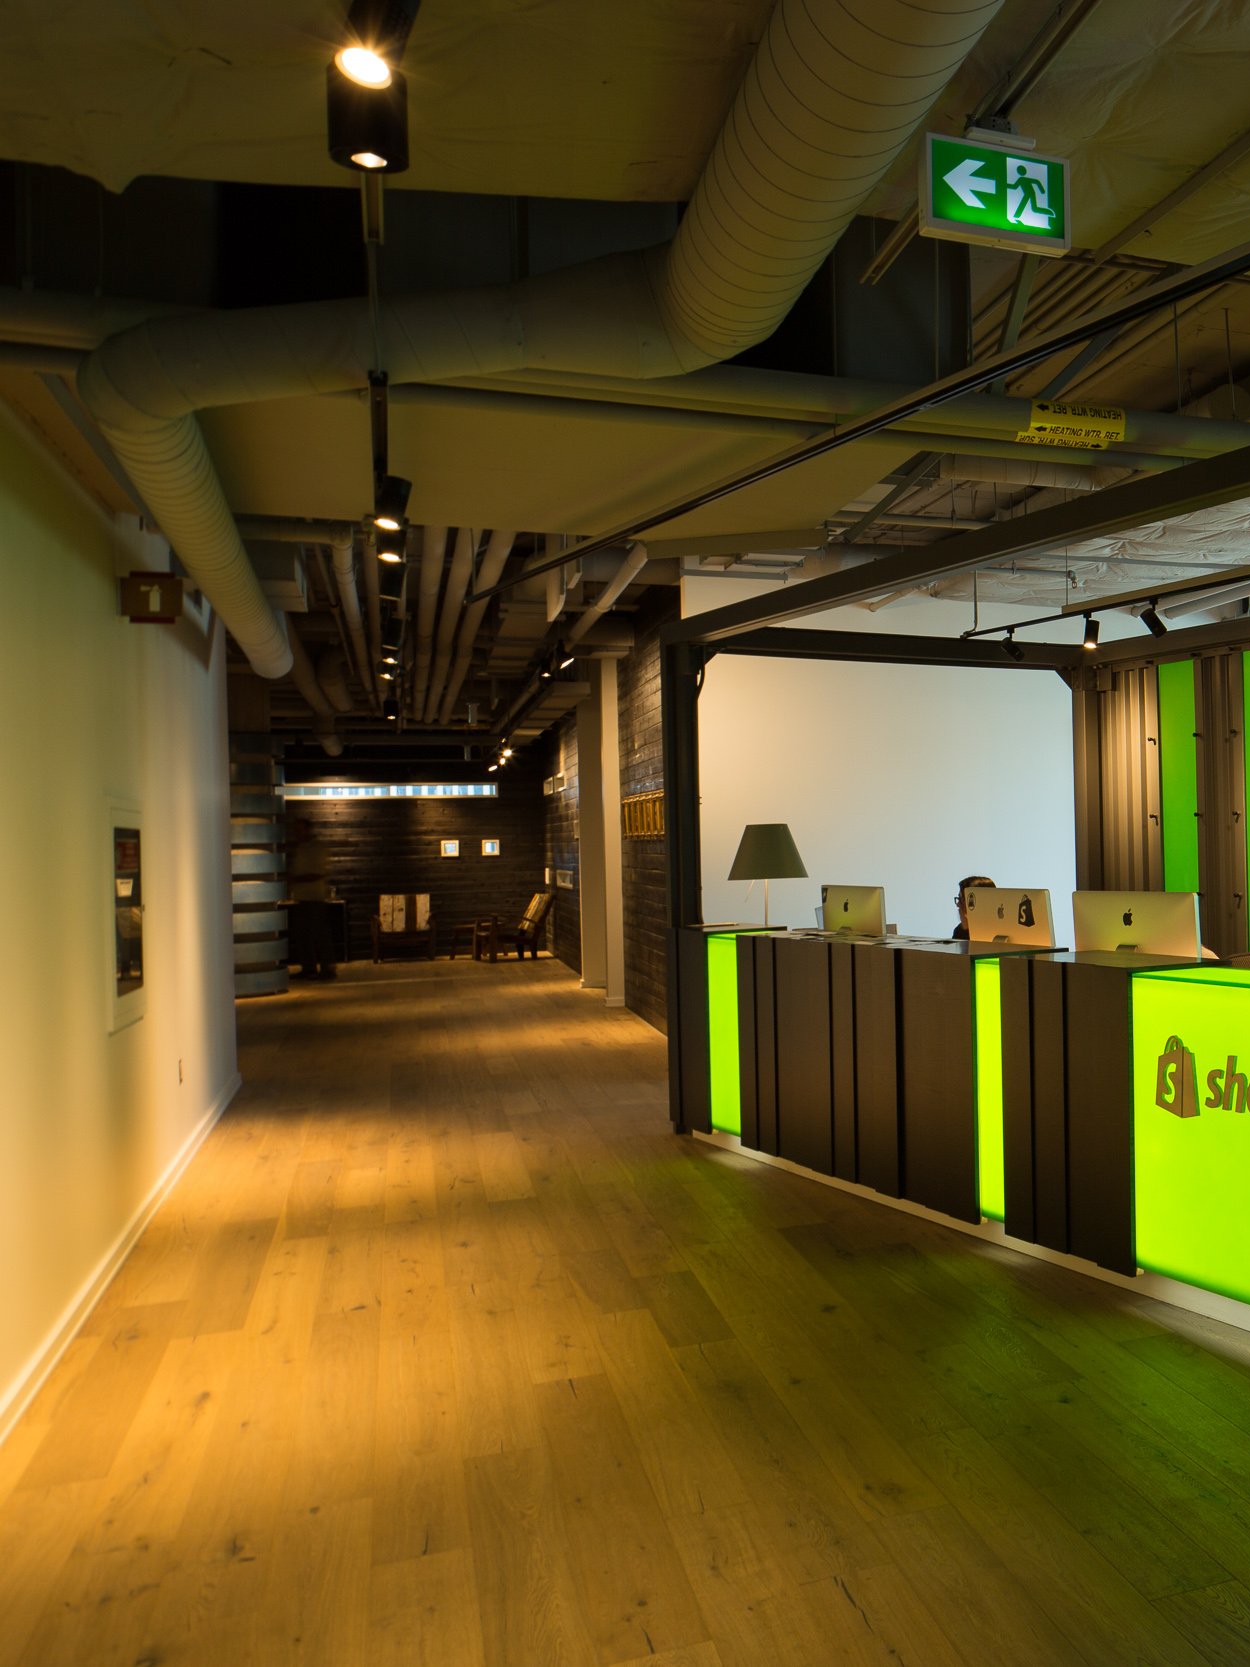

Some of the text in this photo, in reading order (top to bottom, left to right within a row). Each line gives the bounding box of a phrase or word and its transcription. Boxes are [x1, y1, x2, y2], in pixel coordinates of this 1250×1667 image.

[1090, 407, 1122, 420] HEATING
[1049, 426, 1120, 441] HEATING WTR. RET.
